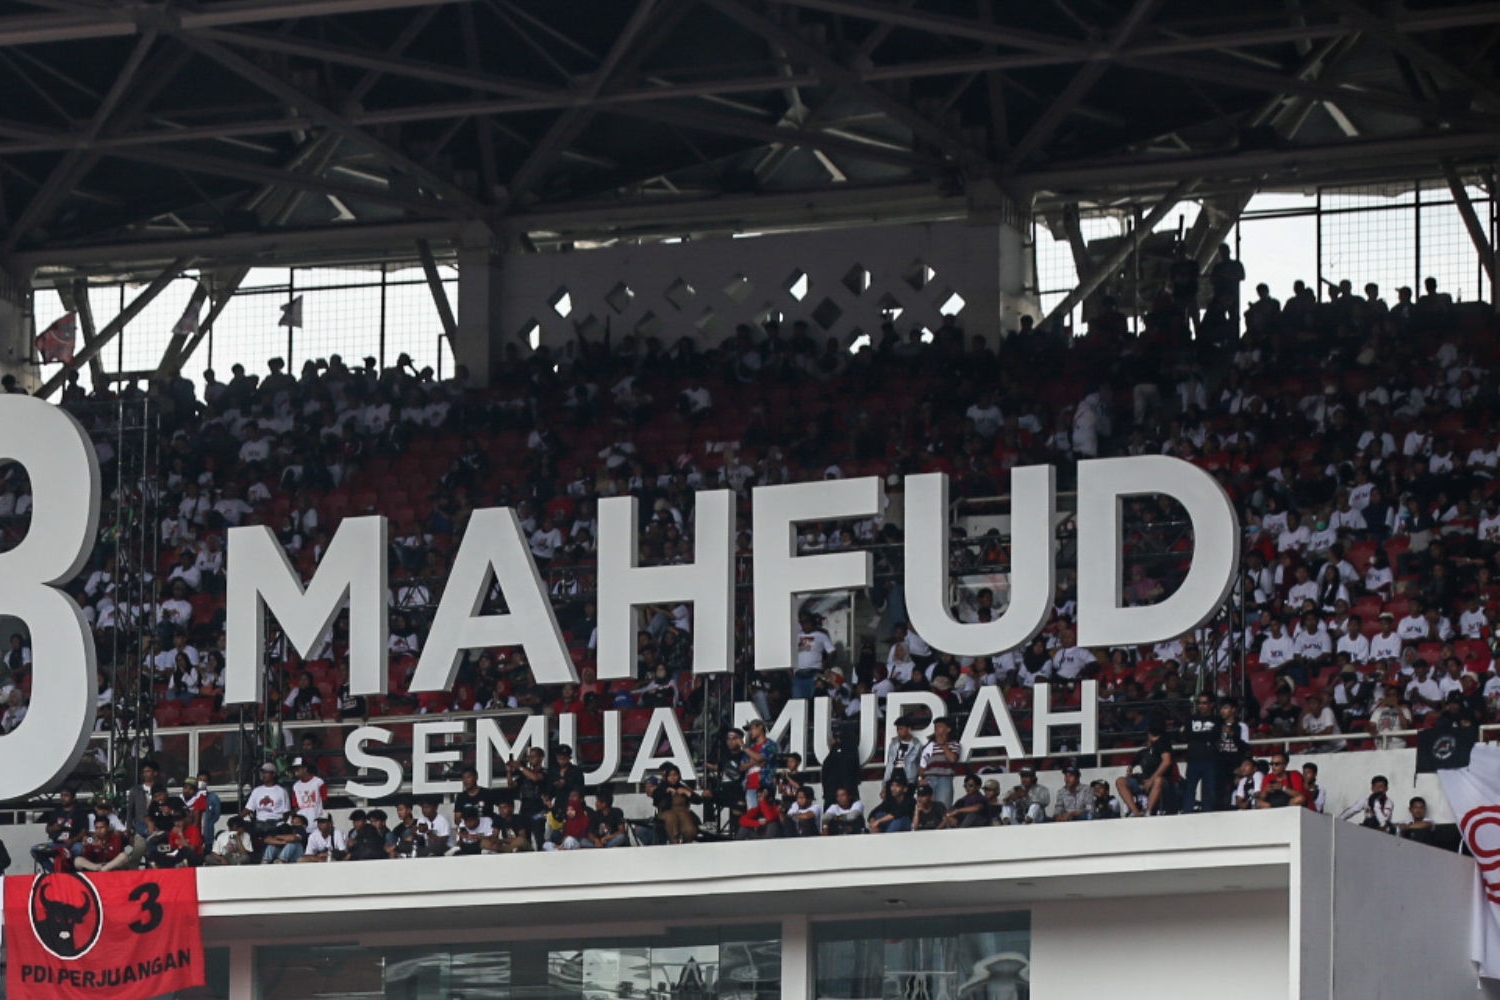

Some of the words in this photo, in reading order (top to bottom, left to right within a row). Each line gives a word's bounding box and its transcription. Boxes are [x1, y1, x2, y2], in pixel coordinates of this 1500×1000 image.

[224, 454, 1241, 703] MAHFUD
[344, 707, 698, 799] SEMUA
[127, 882, 164, 934] 3
[21, 964, 52, 984] PDI
[57, 948, 192, 989] PERJUANGAN
